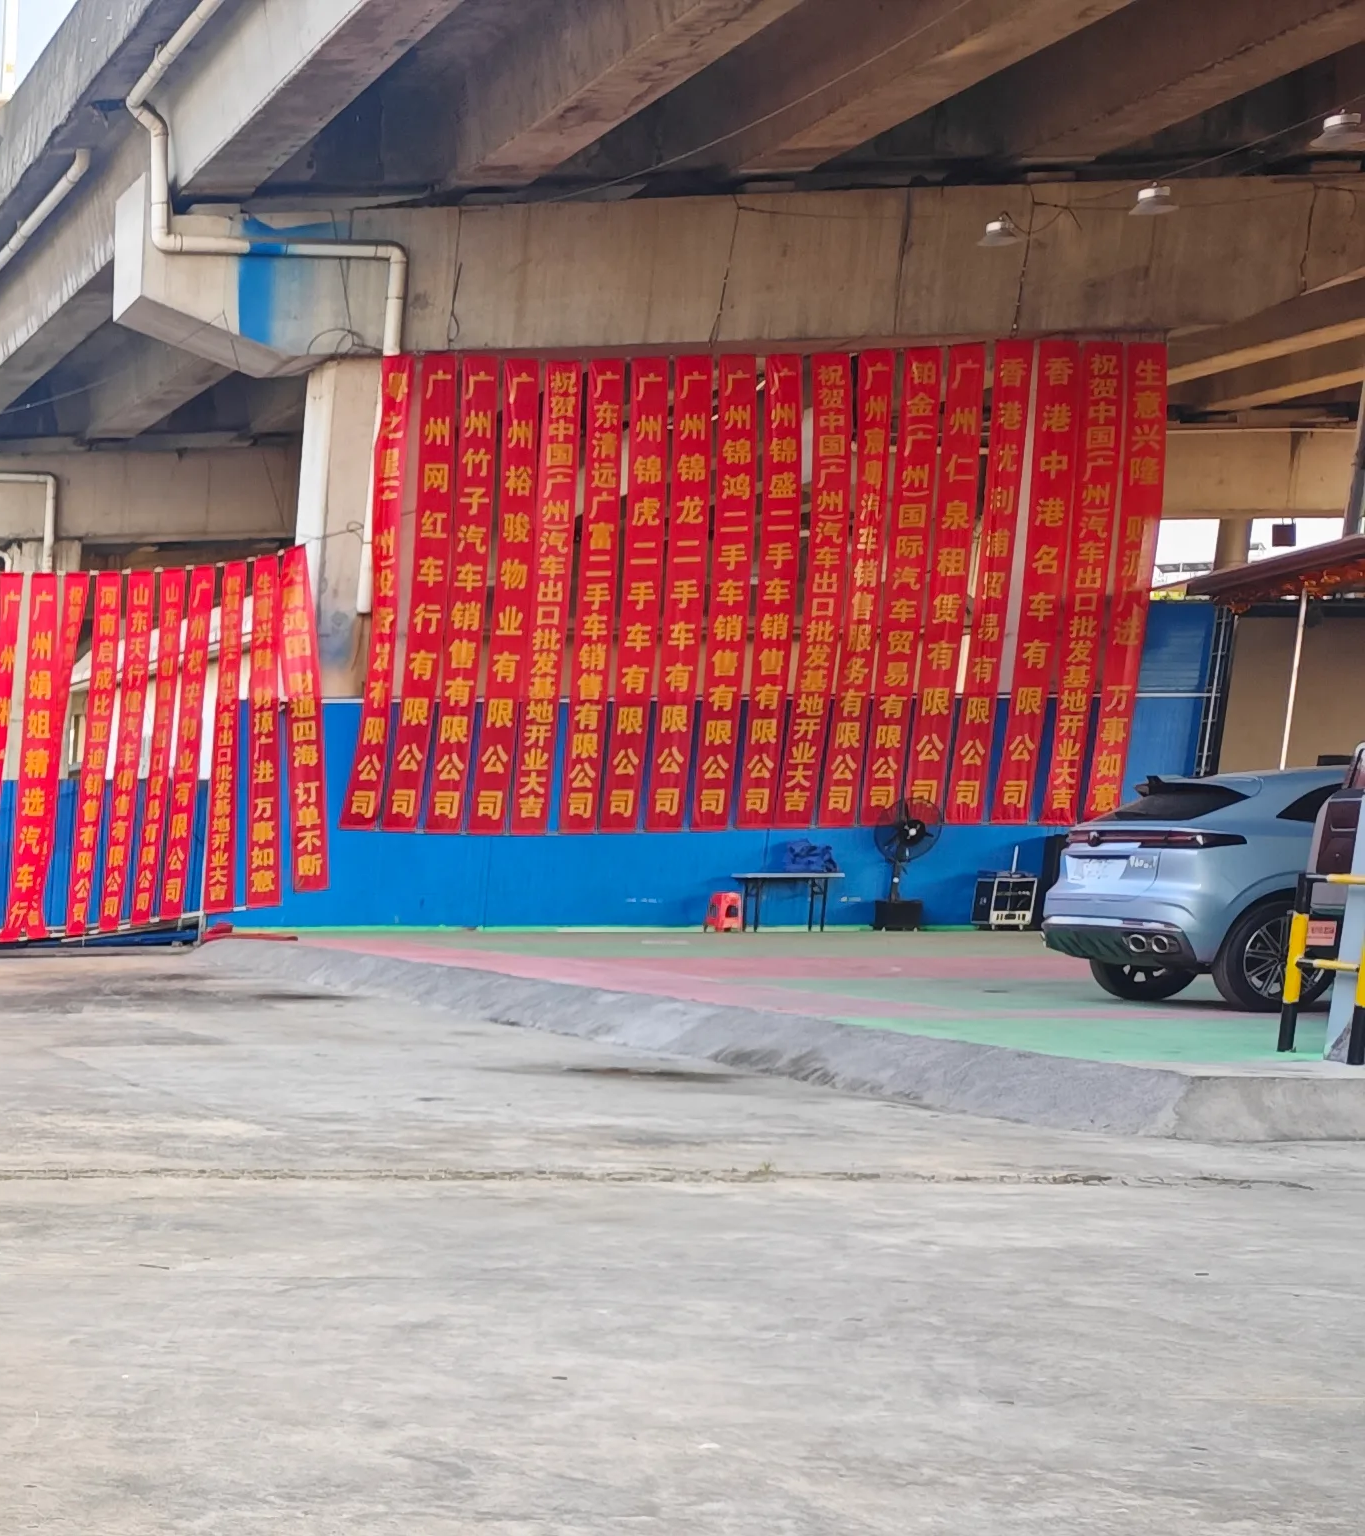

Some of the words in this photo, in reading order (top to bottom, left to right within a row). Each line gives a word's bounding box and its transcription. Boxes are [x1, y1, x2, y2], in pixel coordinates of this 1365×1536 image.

[254, 571, 275, 672] 生意兴隆
[391, 369, 452, 818] 广州网红车行有限公司
[433, 370, 495, 819] 广州竹子汽车销售有限公司
[476, 370, 535, 820] 广州裕骏物业有限公司
[519, 370, 578, 819] 祝贺中国(广州)汽车出口批发基地开业大吉
[567, 370, 621, 818] 广东清远广富二手车销售有限公司
[609, 371, 664, 817] 广州锦虎二手车有限公司
[654, 369, 708, 816] 广州锦龙二手车有限公司
[700, 369, 751, 814] 广州锦鸿二手车销售有限公司
[744, 367, 797, 813] 广州锦盛二手车销售有限公司
[783, 364, 845, 811] 祝贺中国(广州)汽车出口批发基地开业大吉
[910, 360, 981, 809] 广州仁泉租赁有限公司
[1003, 355, 1074, 808] 香港中港名车有限公司
[1050, 352, 1121, 811] 祝贺中国(广州)汽车出口批发基地开业大吉
[1129, 358, 1164, 486] 生意兴隆
[6, 590, 54, 931] 广州娟姐精选汽车行
[71, 586, 119, 925] 河南启成比亚迪销售有限公司
[249, 796, 276, 894] 万事如意
[253, 687, 275, 785] 财源广进
[294, 780, 322, 878] 订单不断
[1091, 683, 1134, 812] 万事如意
